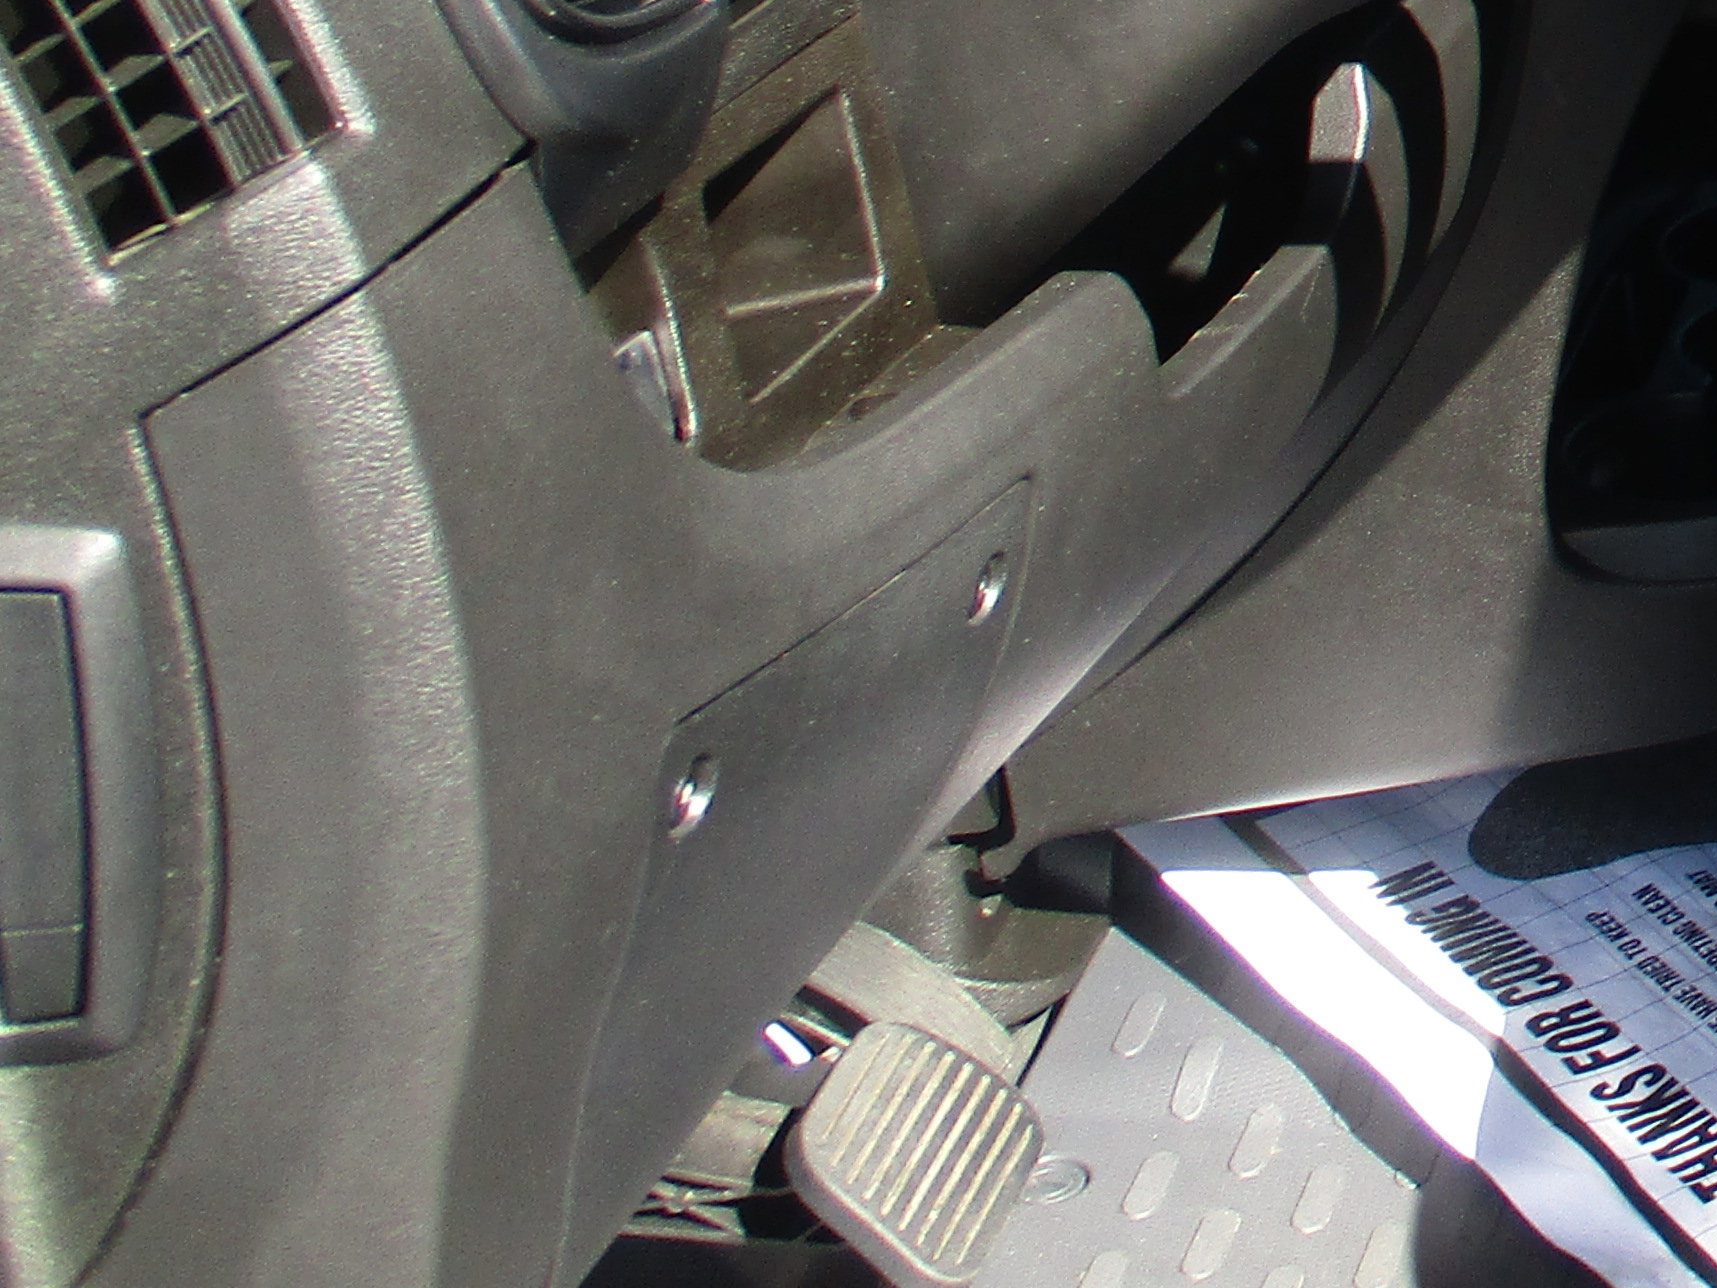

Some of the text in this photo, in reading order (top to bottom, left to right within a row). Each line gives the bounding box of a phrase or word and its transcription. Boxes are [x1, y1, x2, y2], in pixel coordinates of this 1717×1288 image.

[1365, 858, 1456, 909] IN
[1629, 880, 1687, 927] CLEAN
[1581, 908, 1632, 943] KEEP
[1614, 935, 1650, 961] TO
[1400, 891, 1576, 1013] COMING
[1632, 952, 1686, 994] TRIED
[1519, 996, 1643, 1079] FOR
